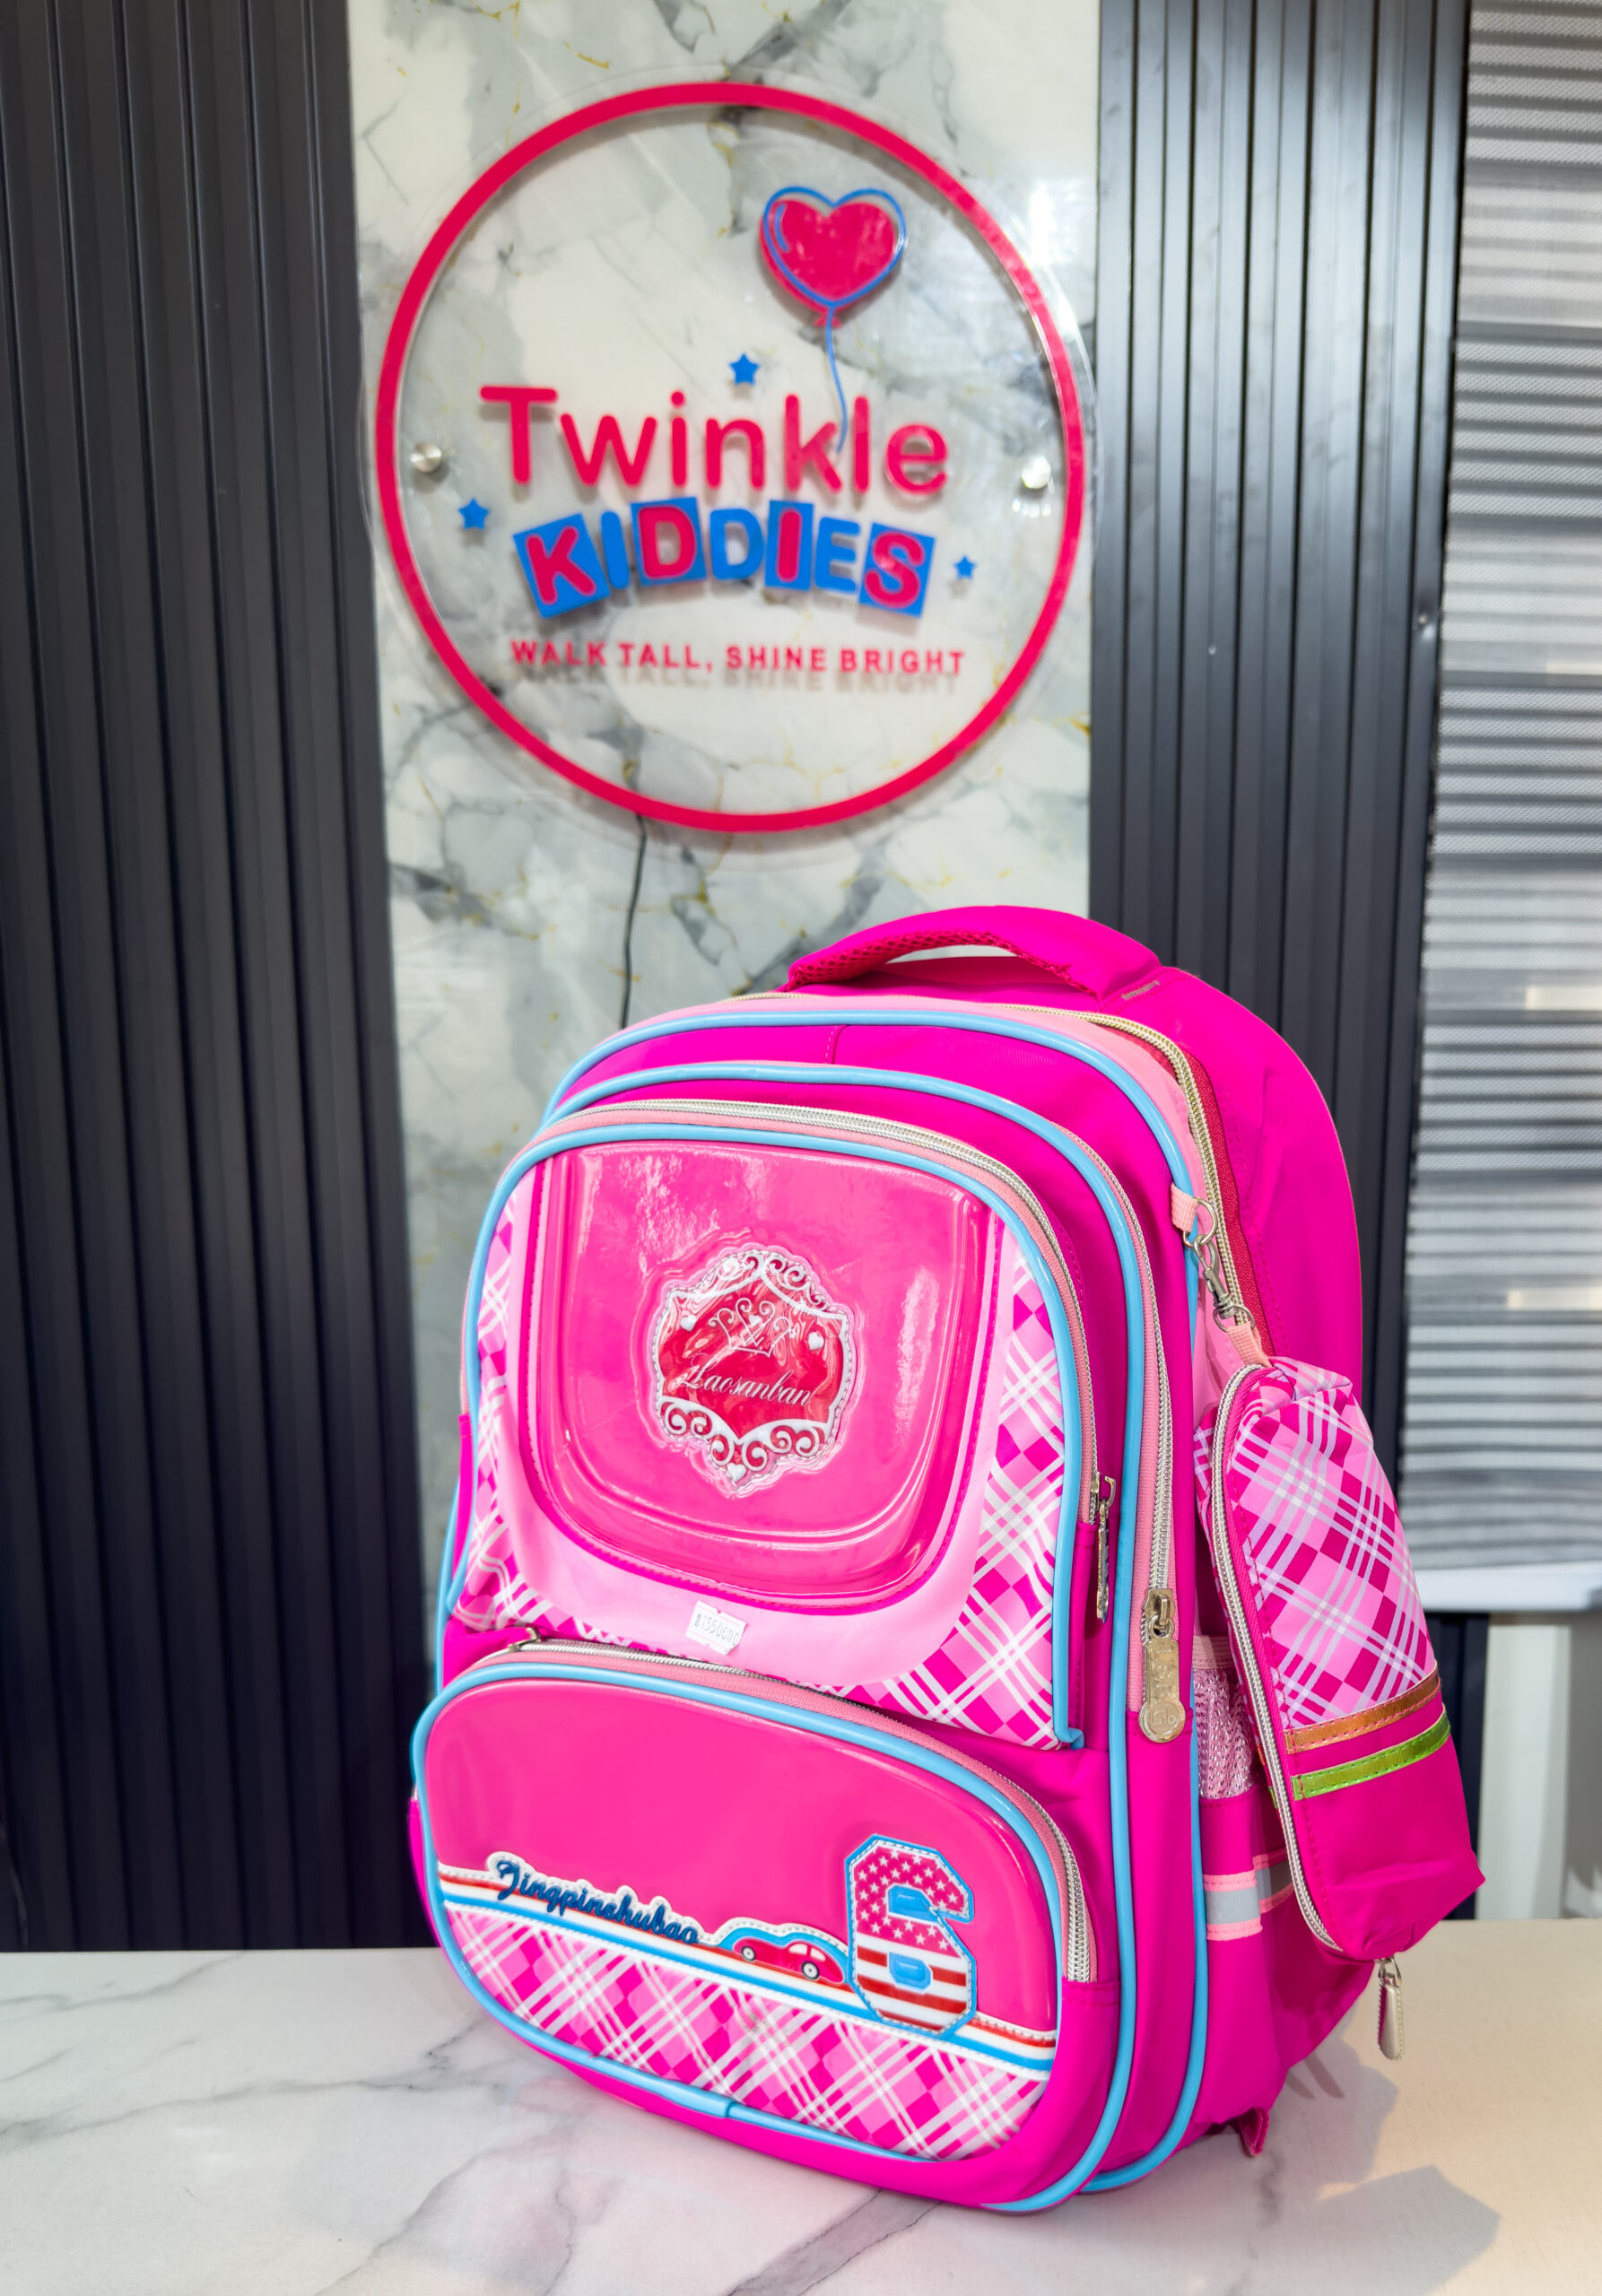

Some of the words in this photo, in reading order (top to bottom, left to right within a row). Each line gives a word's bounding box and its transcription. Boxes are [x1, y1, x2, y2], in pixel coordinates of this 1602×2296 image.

[479, 385, 948, 495] Twinkle
[524, 504, 927, 610] KIDDIES
[511, 639, 606, 666] WALK
[617, 641, 713, 672] TALL,
[726, 645, 826, 672] SHINE
[840, 648, 966, 674] BRIGHT
[496, 1859, 700, 1944] Jingpinshubao
[845, 1834, 977, 2039] 6
